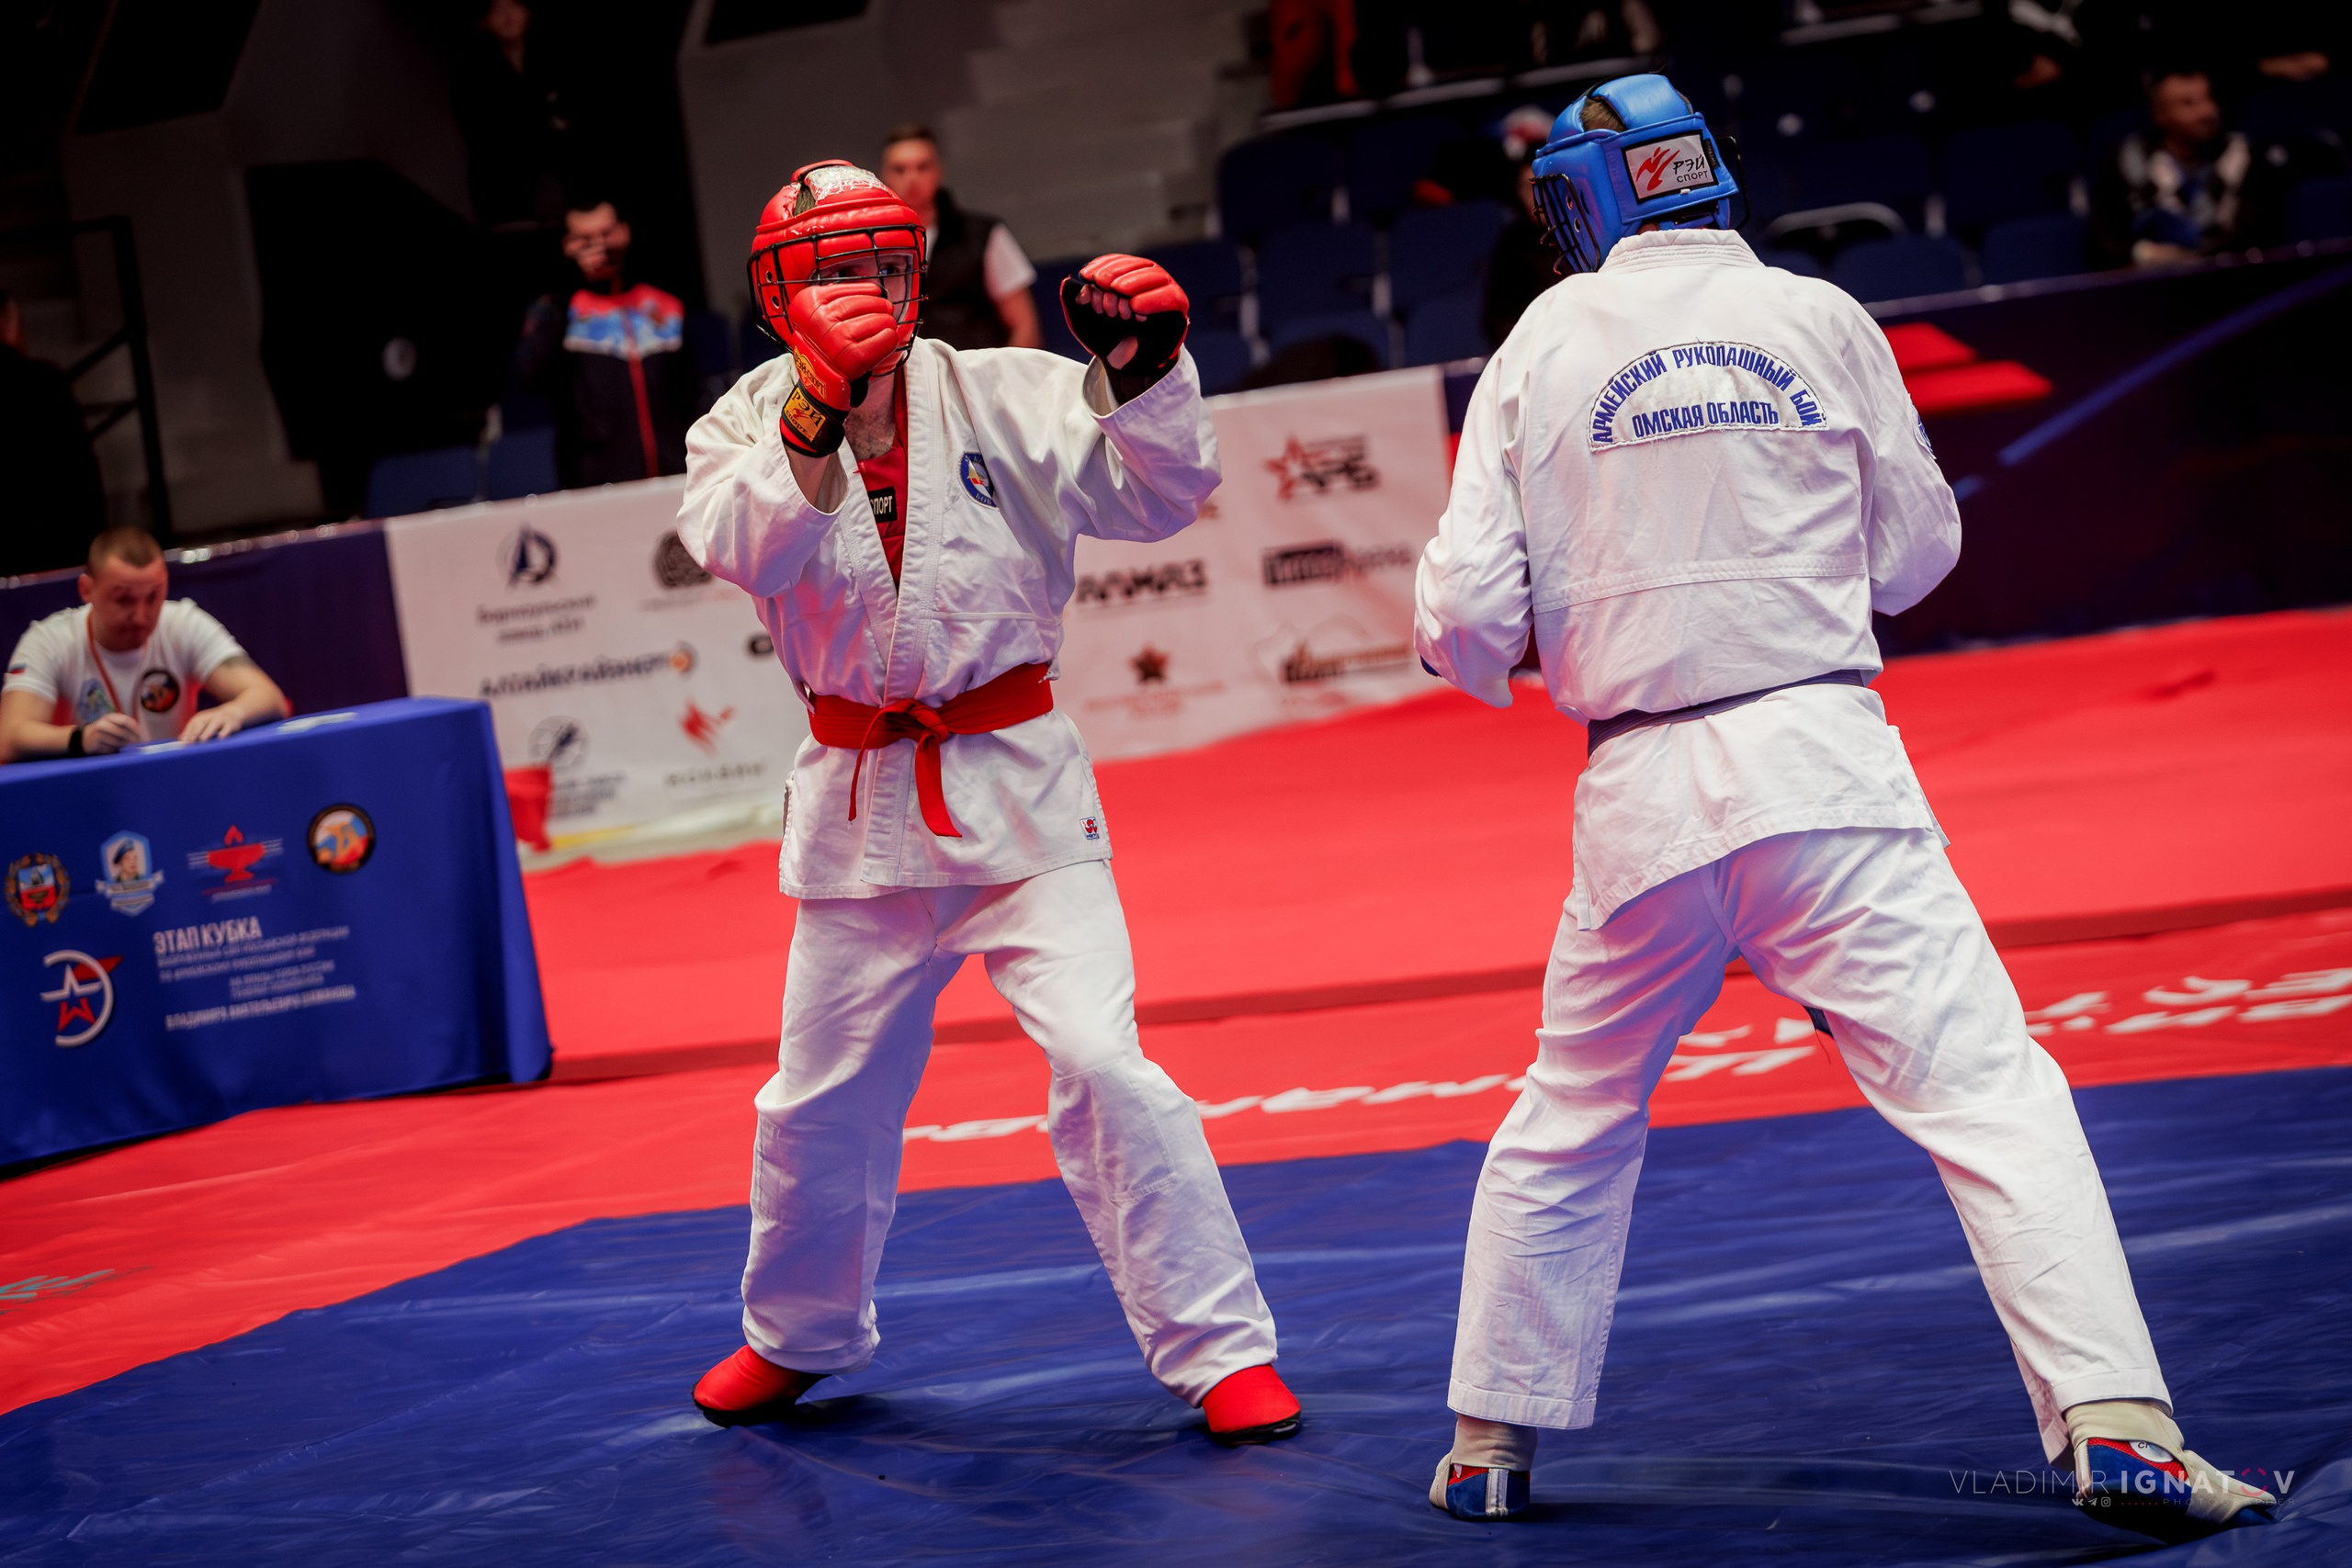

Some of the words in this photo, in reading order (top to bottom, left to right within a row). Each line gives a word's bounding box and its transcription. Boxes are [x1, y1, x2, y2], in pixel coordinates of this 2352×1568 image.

[1592, 351, 1668, 443] АРМЕЙСКИЙ
[1672, 345, 1796, 391] РУКОПАШНЫЙ
[1789, 389, 1826, 426] БОЙ
[1631, 404, 1704, 438] ОМСКАЯ
[1706, 400, 1780, 424] ОБЛАСТЬ
[153, 926, 200, 956] ЭТАП
[200, 916, 263, 949] КУБКА
